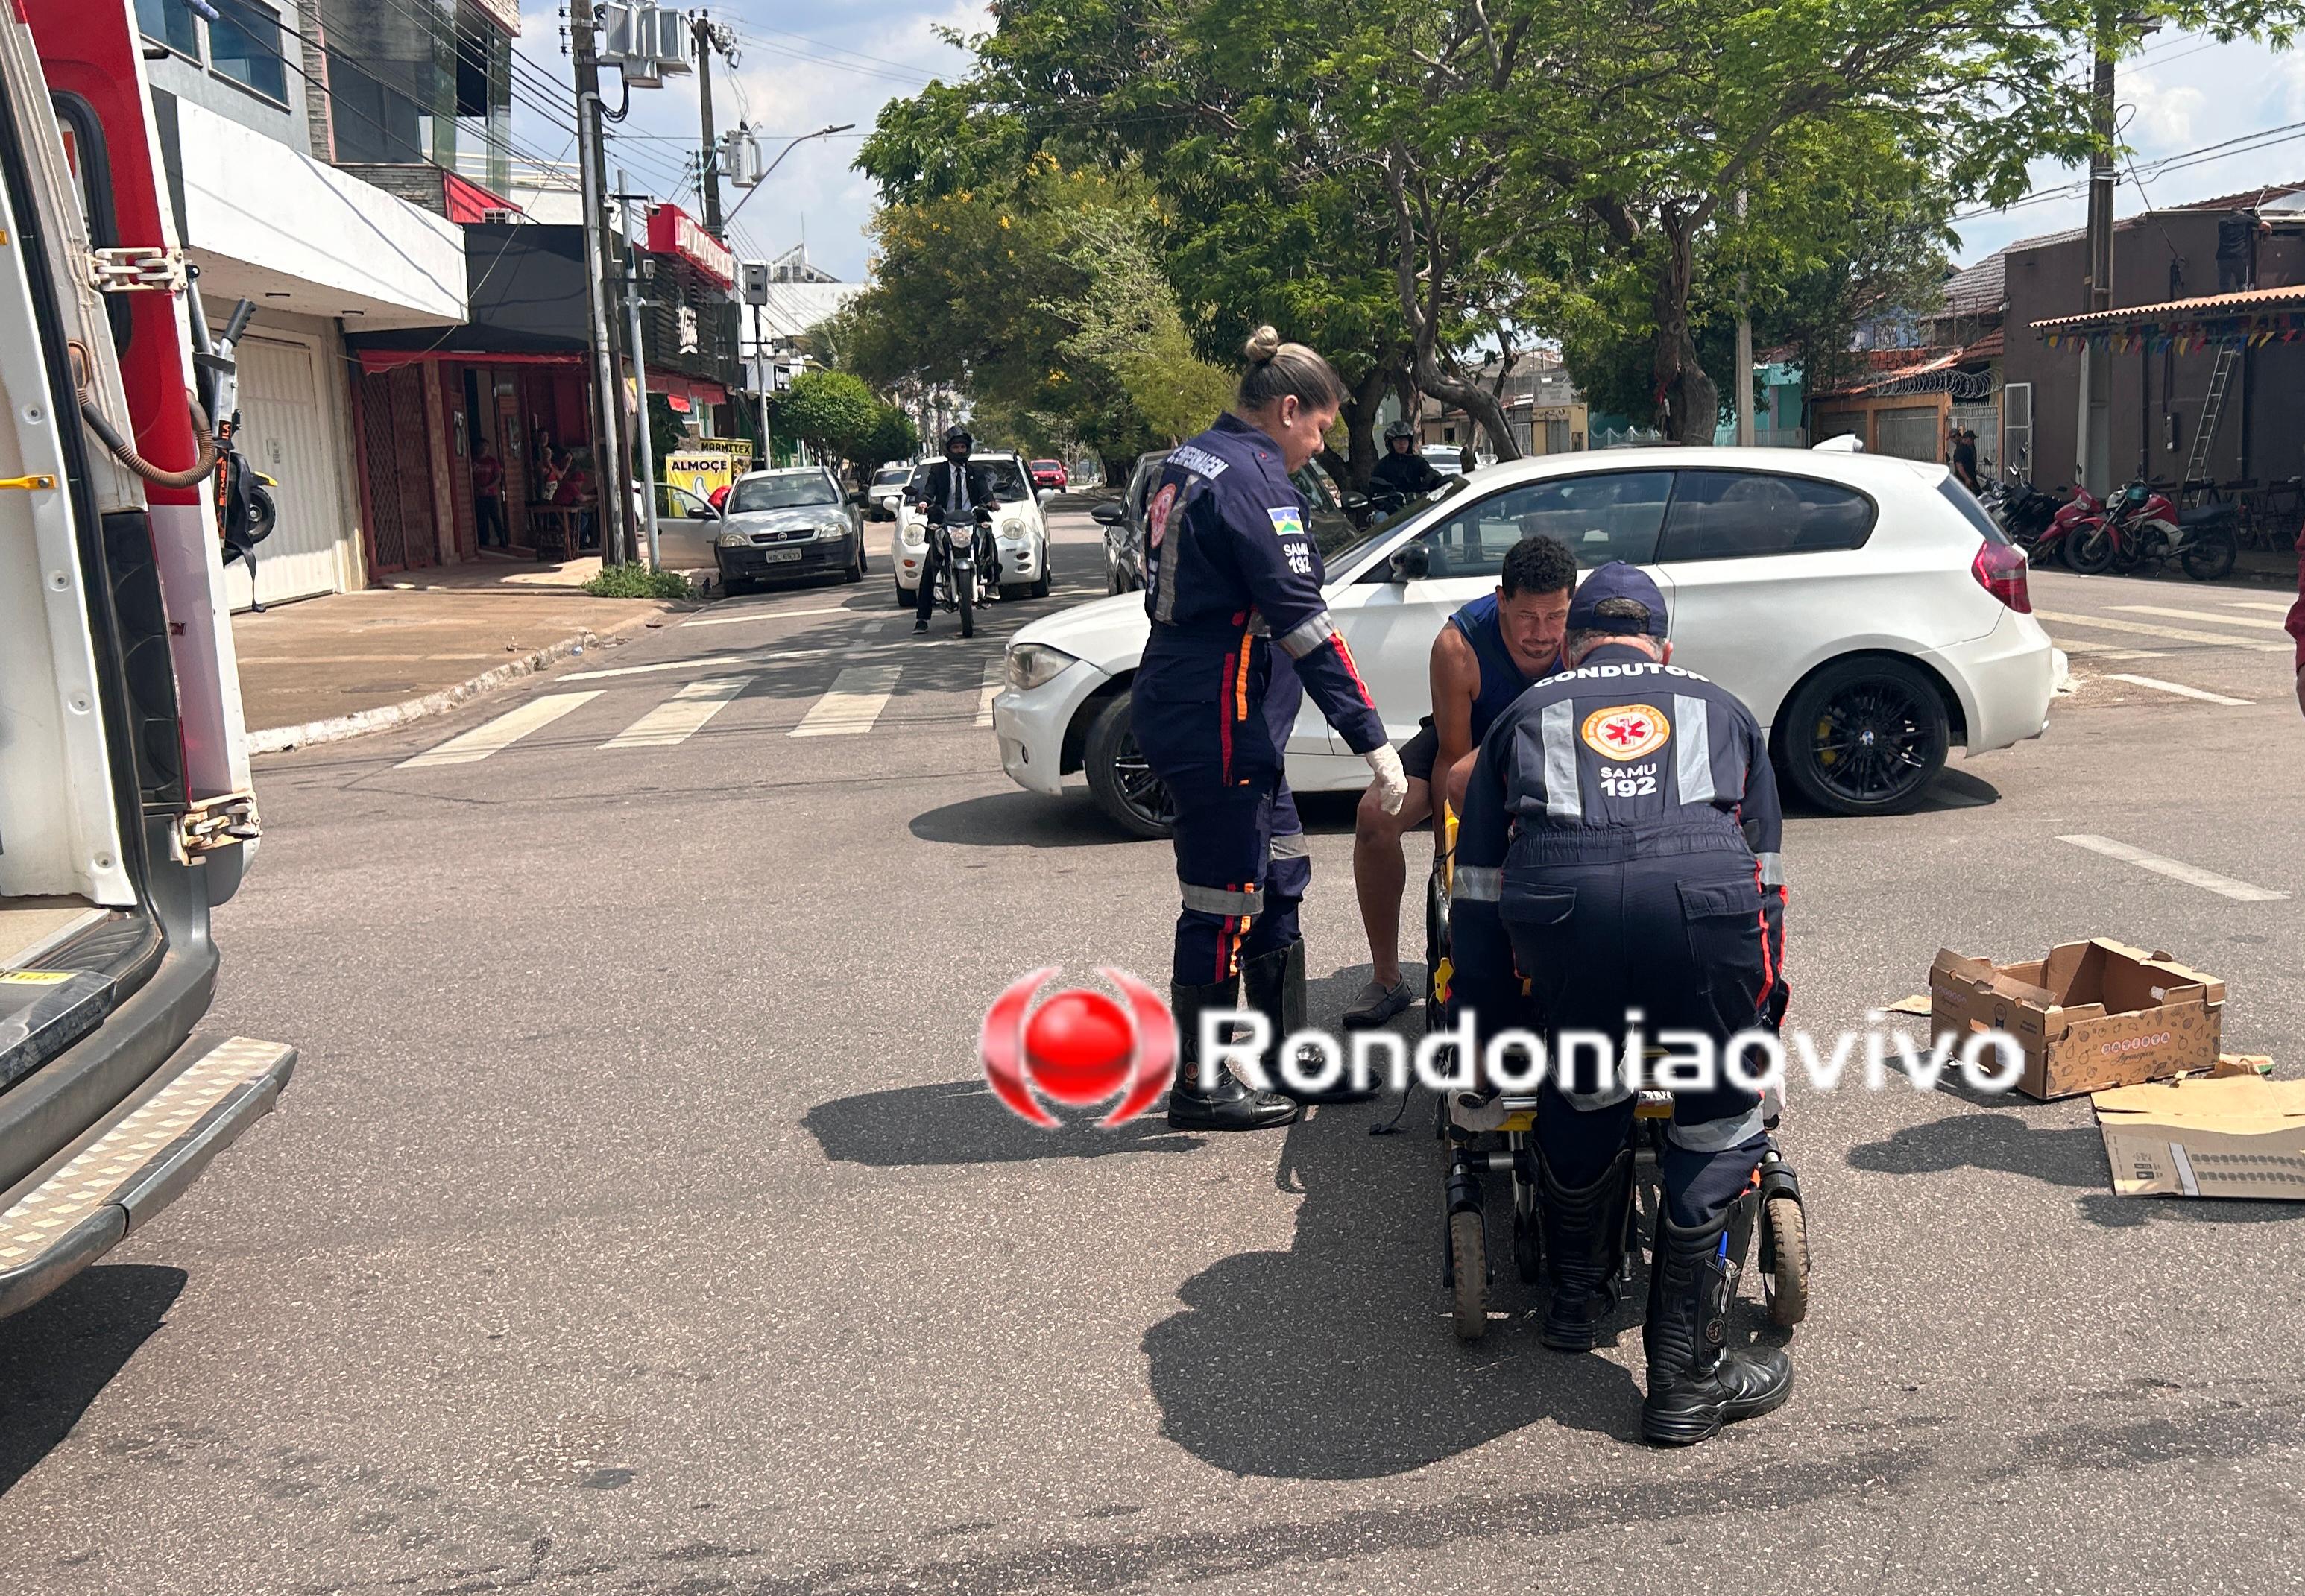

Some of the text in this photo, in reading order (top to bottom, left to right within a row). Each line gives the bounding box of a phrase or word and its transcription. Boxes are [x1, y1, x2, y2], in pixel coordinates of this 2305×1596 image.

[701, 441, 751, 454] MARMITEX
[671, 460, 728, 473] ALMOÇE
[1288, 555, 1312, 574] 192
[1533, 662, 1711, 688] CONDUTOR
[1600, 763, 1657, 779] SAMU
[1600, 776, 1657, 798] 192
[2101, 1032, 2170, 1055] BATISTA
